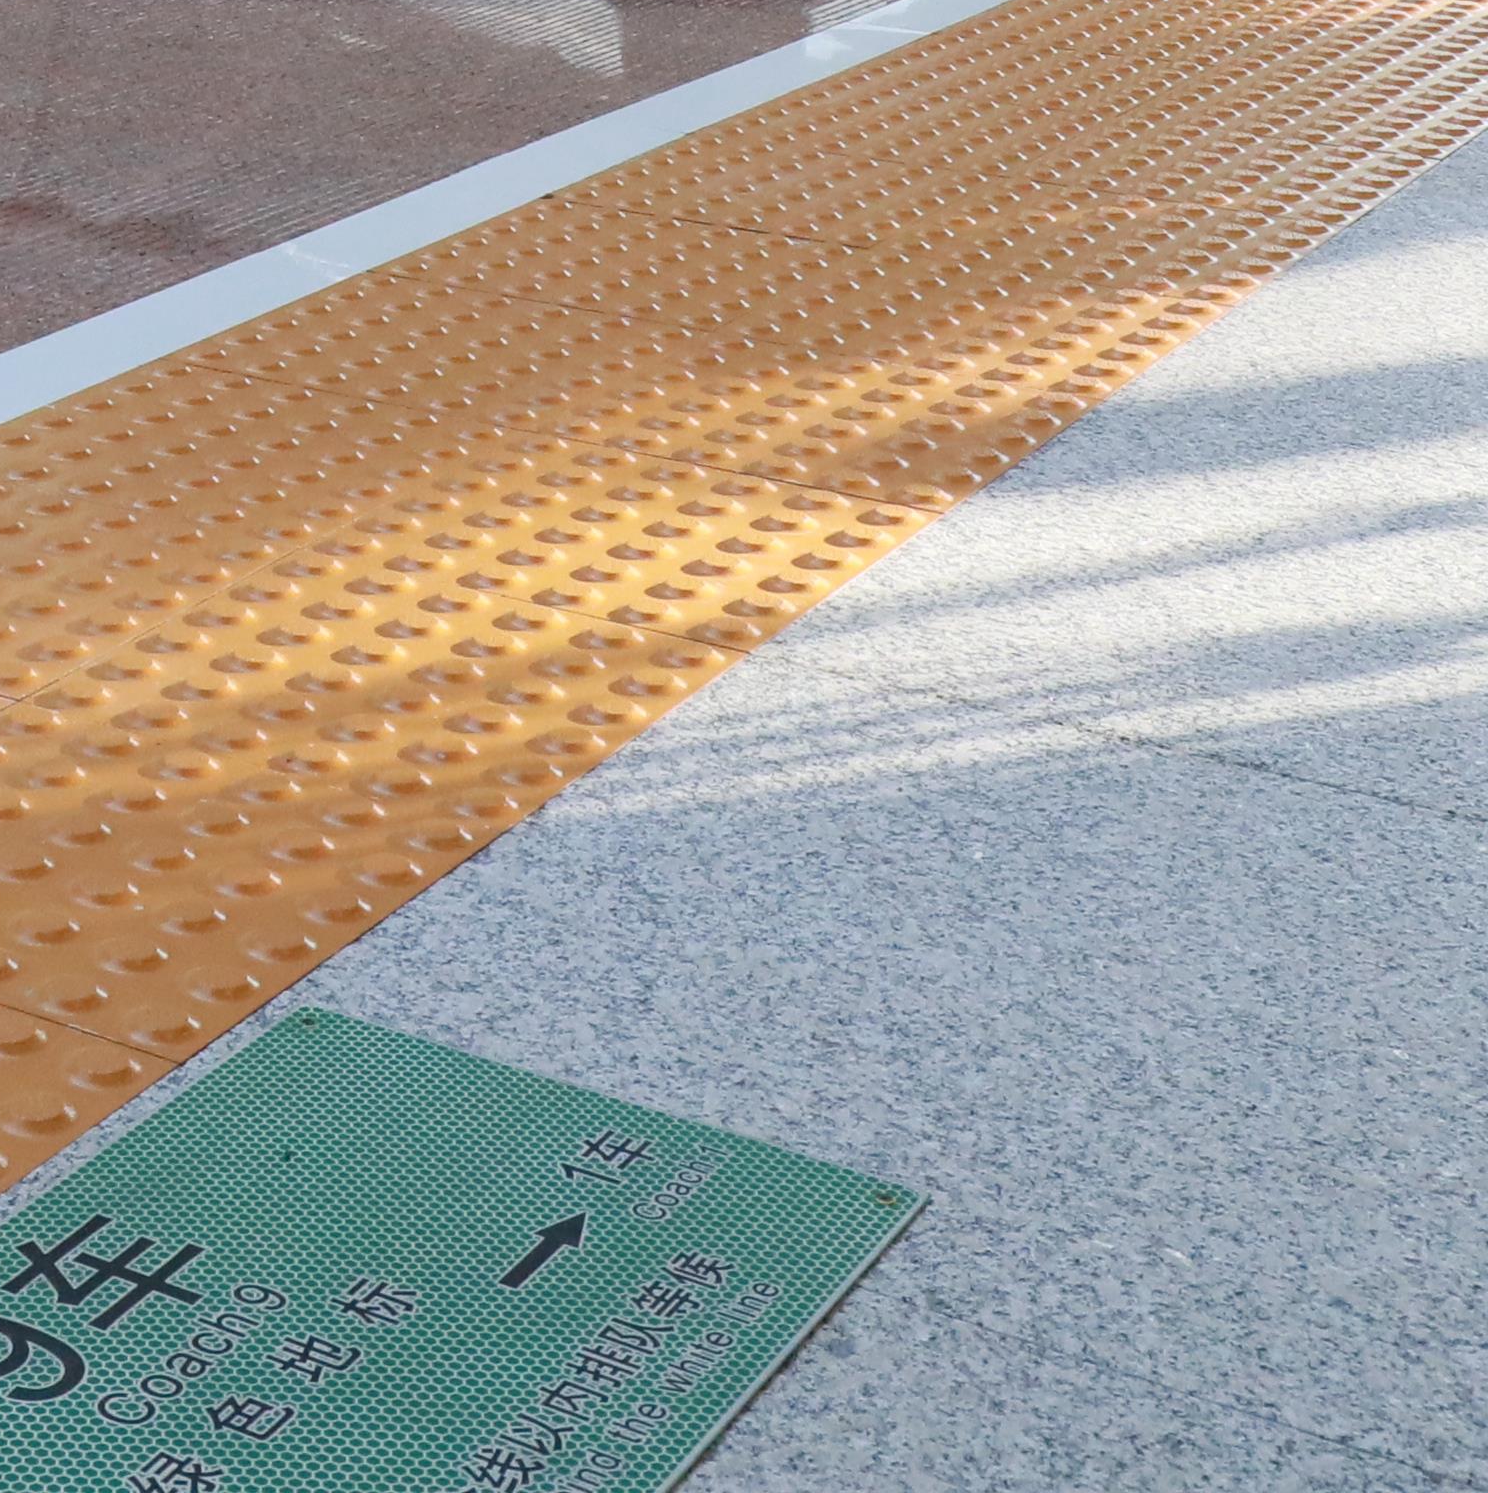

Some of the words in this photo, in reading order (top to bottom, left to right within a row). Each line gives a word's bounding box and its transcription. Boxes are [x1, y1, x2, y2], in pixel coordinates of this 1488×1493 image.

[561, 1130, 657, 1185] 1车
[633, 1160, 716, 1220] Coach
[698, 1144, 728, 1156] 1
[97, 1312, 262, 1426] Coach
[233, 1284, 287, 1311] 9
[462, 1251, 735, 1493] 线以内排队等候
[564, 1449, 622, 1493] ind
[608, 1401, 667, 1444] the
[661, 1330, 735, 1397] white
[719, 1281, 780, 1330] line
